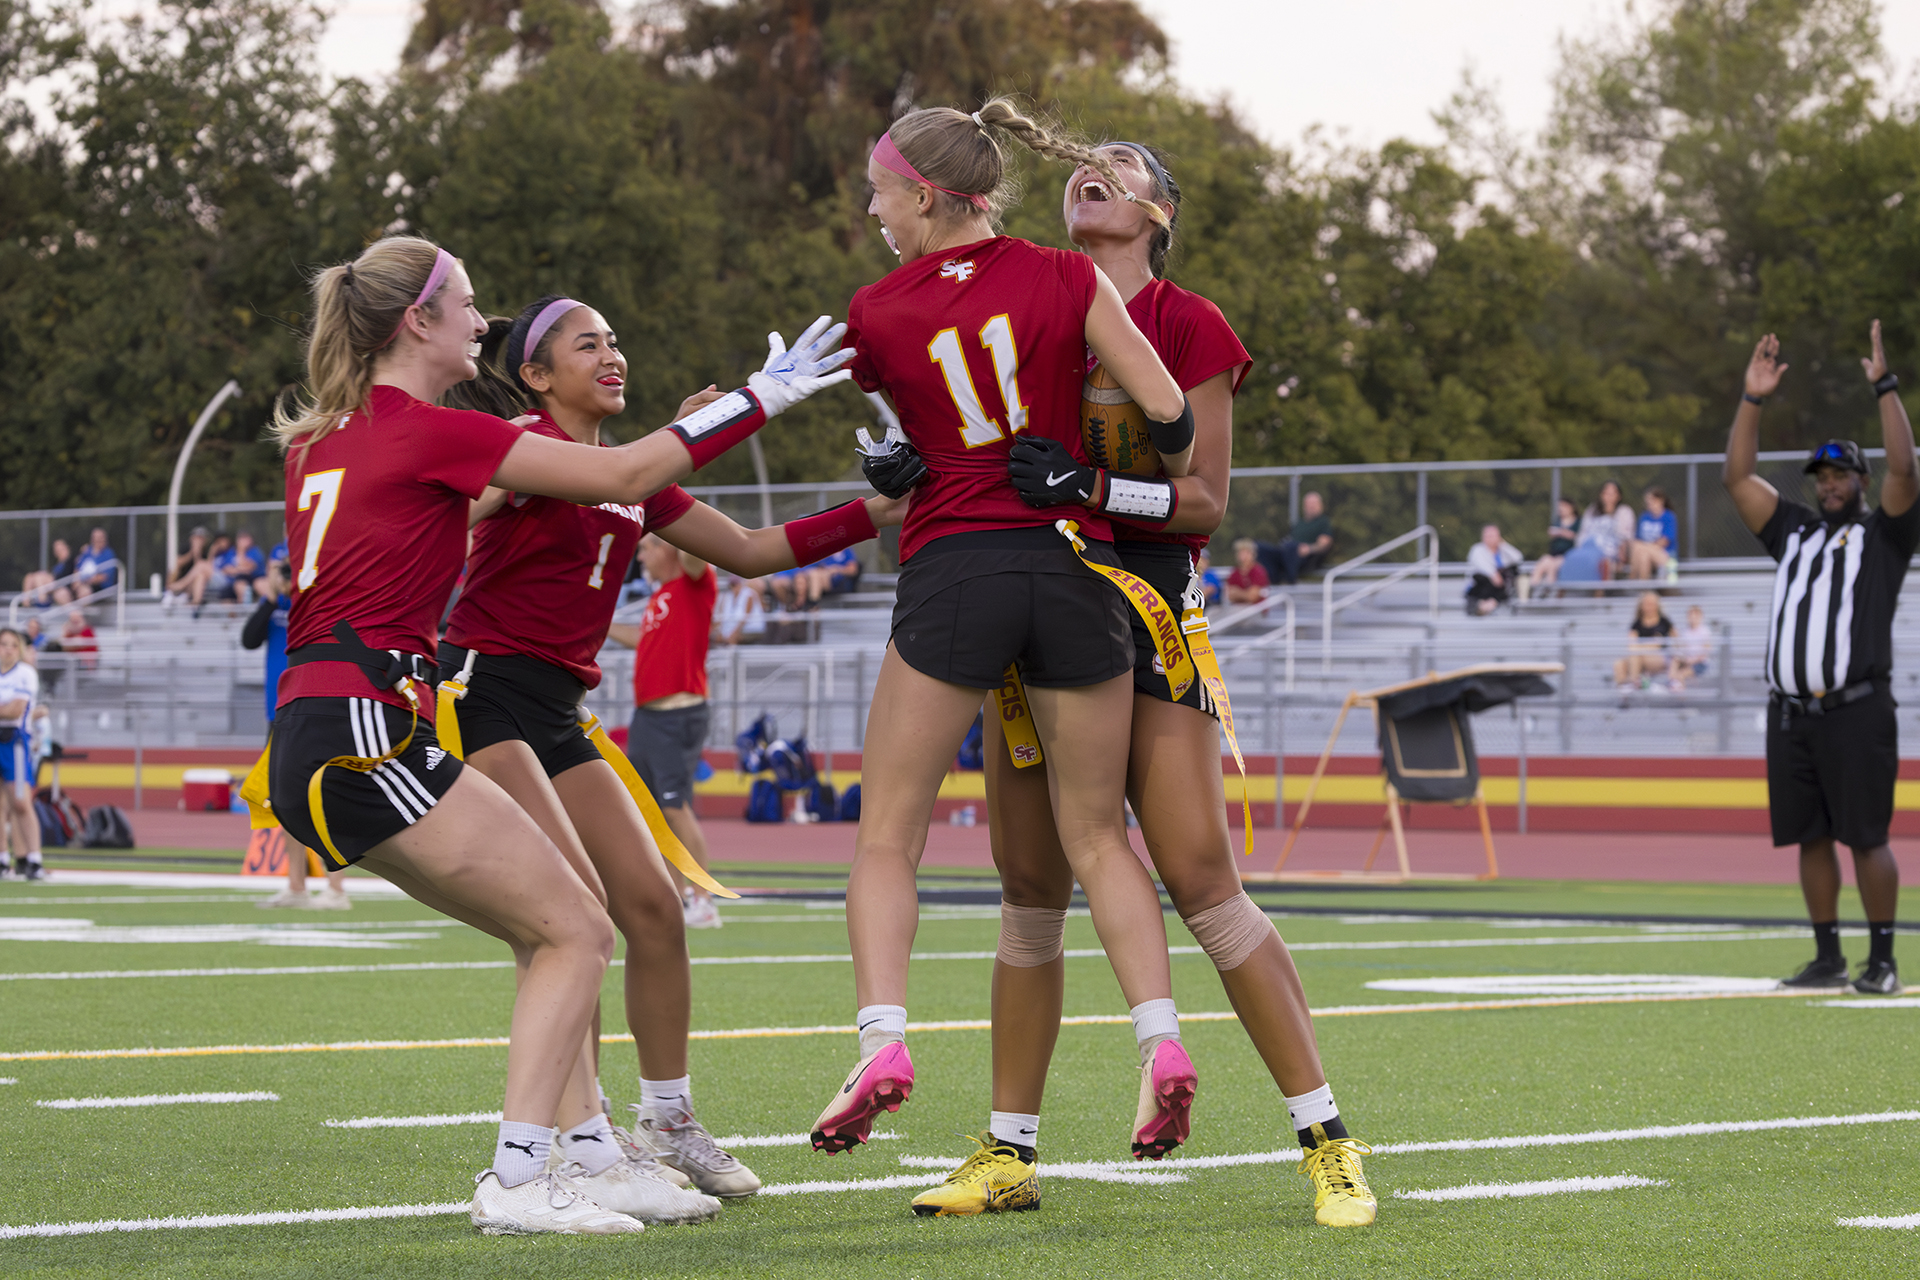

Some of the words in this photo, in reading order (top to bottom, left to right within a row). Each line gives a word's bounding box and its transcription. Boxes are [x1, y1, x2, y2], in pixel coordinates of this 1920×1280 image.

[938, 258, 977, 283] SF
[927, 313, 1029, 449] 11
[1115, 419, 1133, 471] Wilson
[1136, 429, 1148, 456] GST
[298, 468, 346, 593] 7
[587, 533, 616, 590] 1
[1128, 580, 1184, 670] FRANCIS
[1013, 742, 1037, 762] SF
[250, 828, 288, 872] 30
